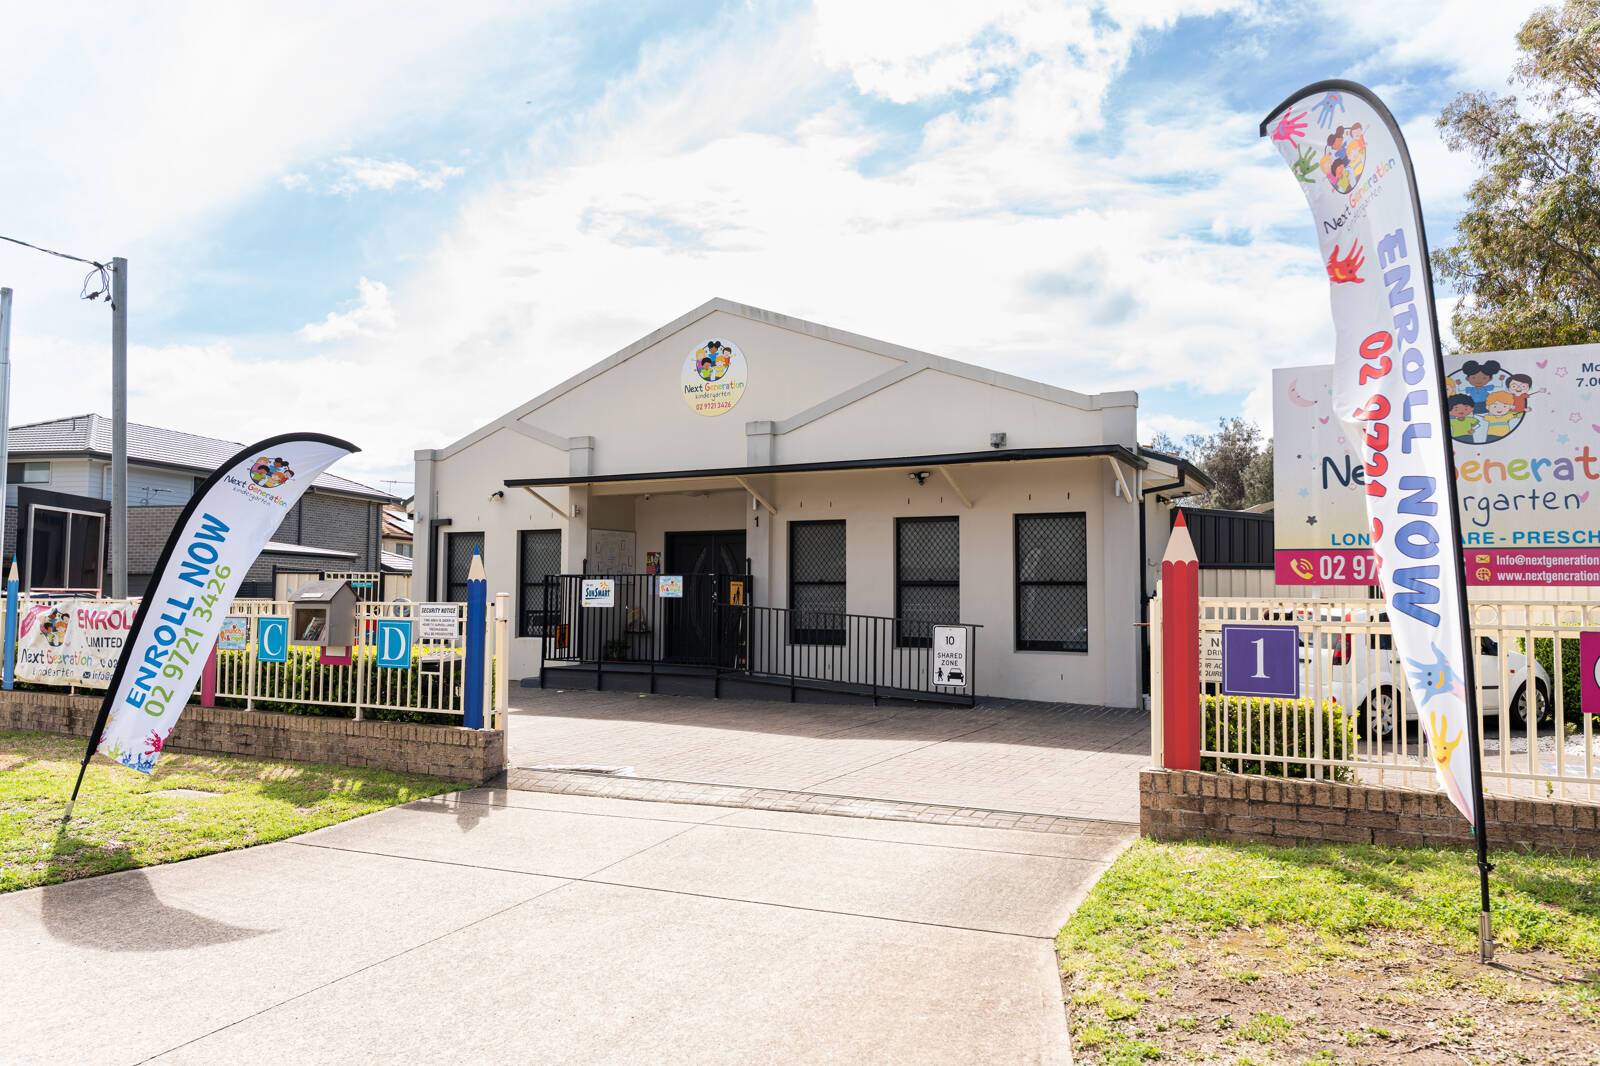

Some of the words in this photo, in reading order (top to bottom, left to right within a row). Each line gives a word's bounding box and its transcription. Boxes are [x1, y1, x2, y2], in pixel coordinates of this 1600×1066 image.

[1323, 203, 1352, 234] Next
[1376, 228, 1432, 454] ENROLL
[1359, 330, 1393, 385] 02
[684, 383, 704, 395] Next
[704, 381, 744, 392] Generation
[1576, 376, 1600, 388] 7.0
[704, 402, 717, 410] 9721
[717, 401, 732, 409] 3426
[1454, 446, 1600, 485] enerat
[223, 474, 247, 488] Next
[247, 483, 288, 507] Generation
[754, 515, 759, 527] 1
[1331, 533, 1370, 546] LON
[1391, 475, 1441, 628] NOW
[1319, 555, 1346, 581] 02
[76, 608, 136, 631] ENROL
[125, 595, 195, 710] ENROLL
[178, 512, 231, 588] NOW
[86, 636, 122, 649] LIMITED
[143, 682, 174, 718] 02
[162, 625, 204, 681] 9721
[192, 564, 232, 623] 3426
[263, 622, 284, 657] C
[381, 625, 407, 661] D
[945, 635, 955, 646] 10
[941, 659, 959, 667] ZONE
[1250, 637, 1271, 679] 1
